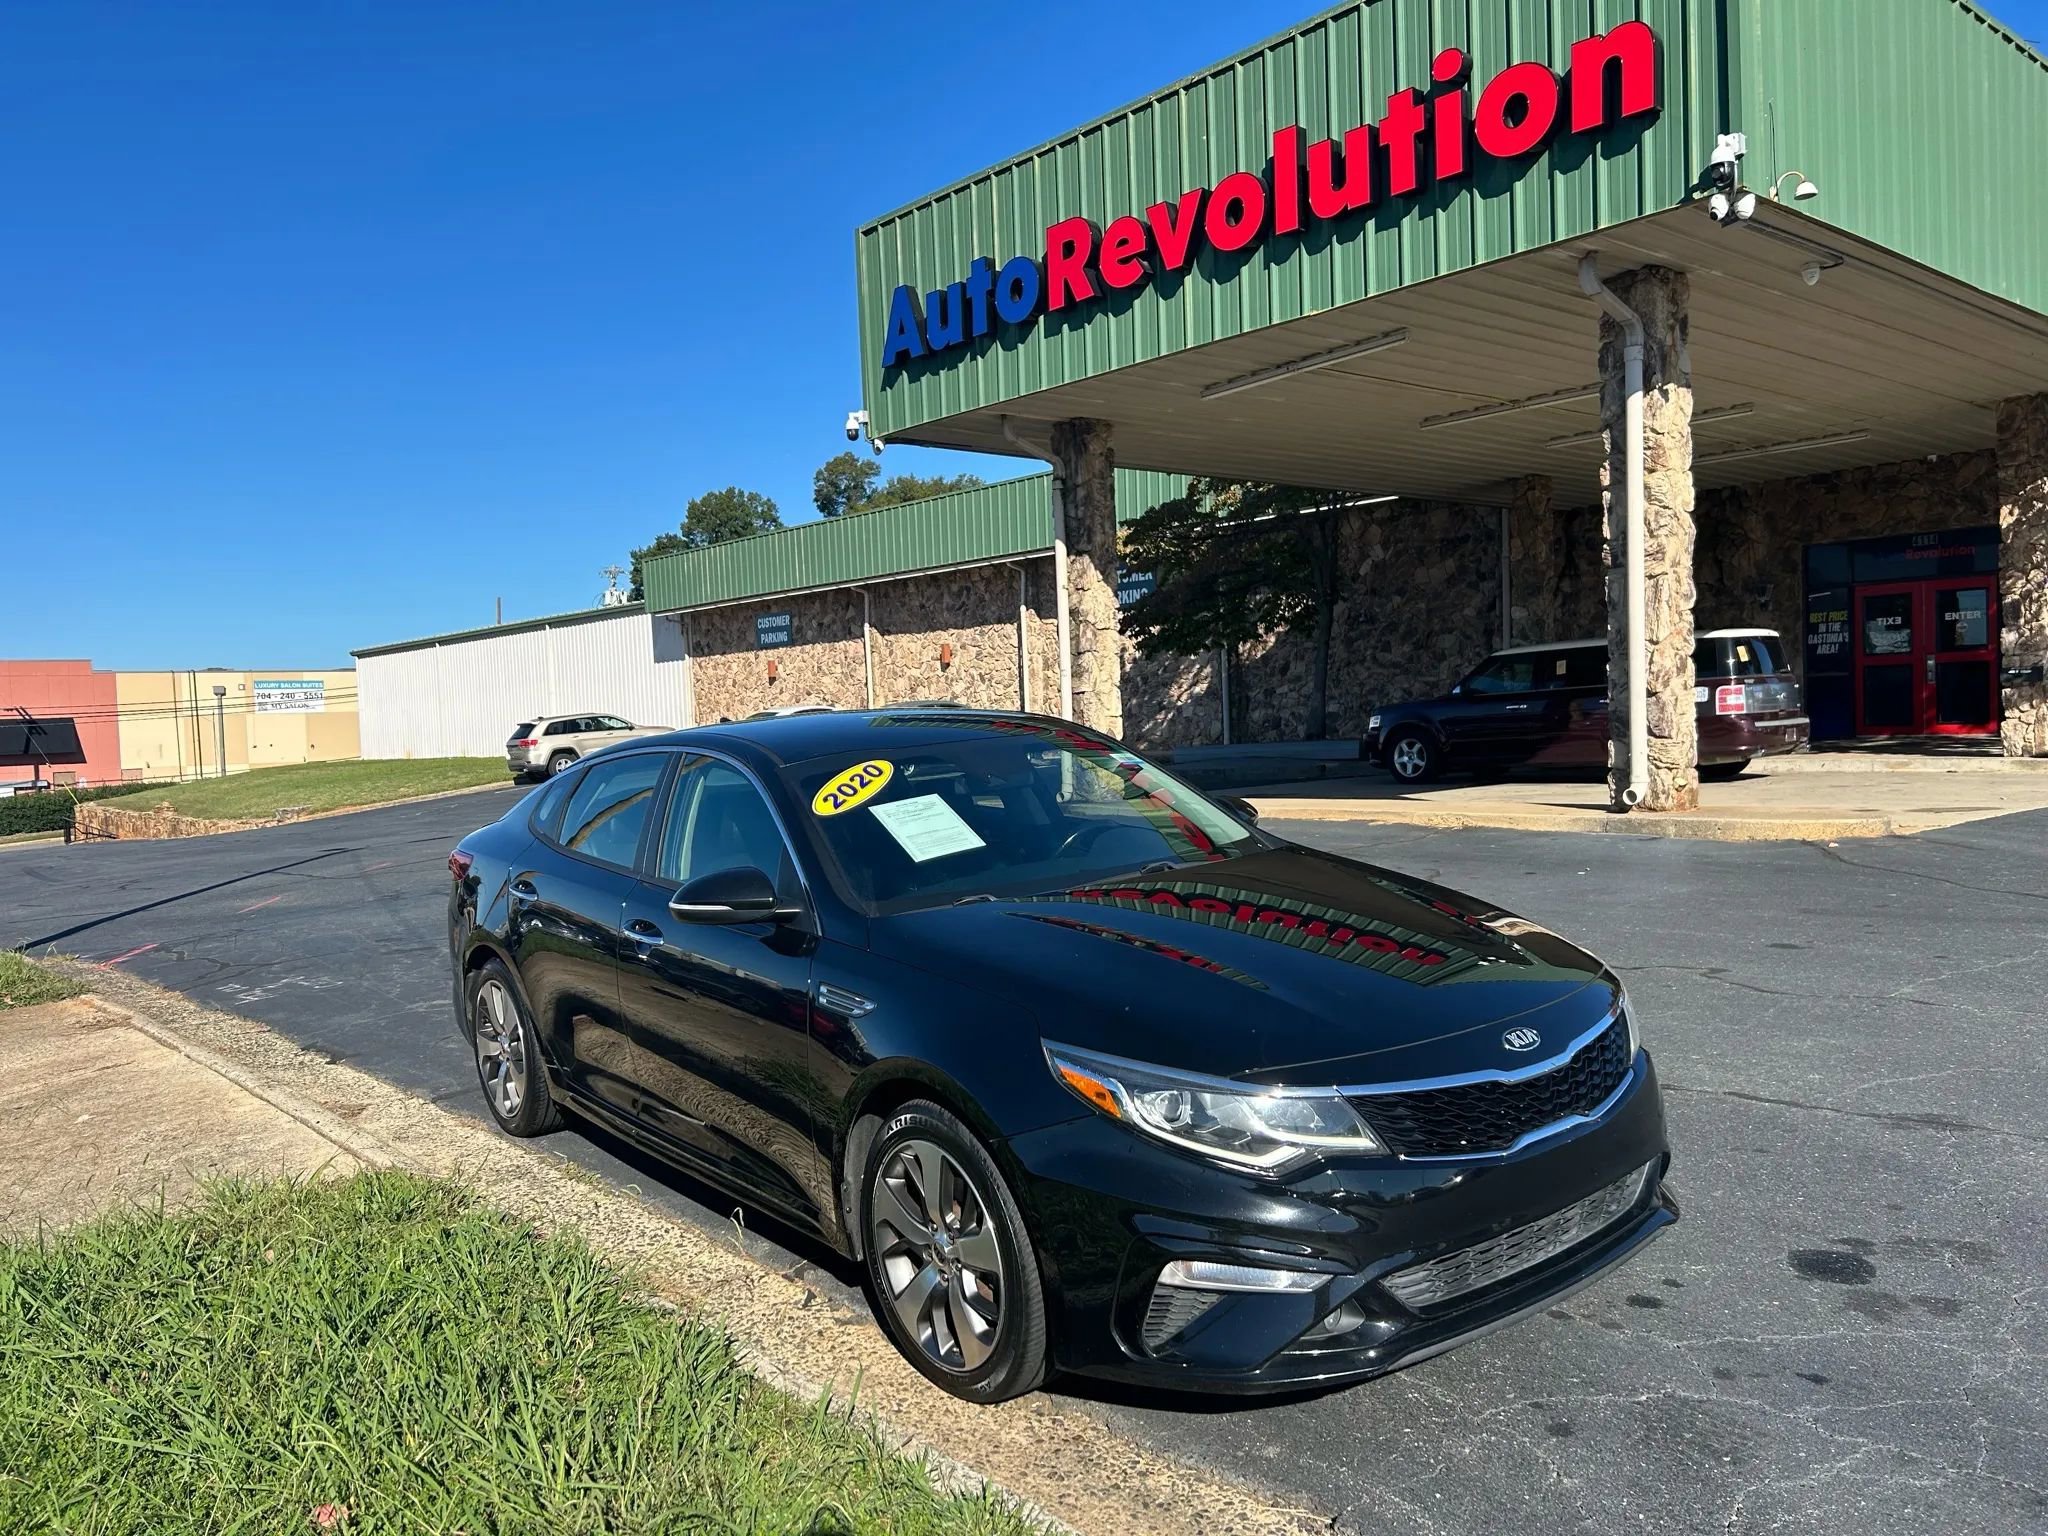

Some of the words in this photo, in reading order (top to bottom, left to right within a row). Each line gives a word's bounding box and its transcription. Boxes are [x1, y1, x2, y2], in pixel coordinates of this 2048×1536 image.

[757, 614, 790, 629] CUSTOMER
[1809, 611, 1828, 624] BEST
[1828, 610, 1849, 622] PRICE
[1944, 610, 1982, 621] ENTER
[1818, 622, 1827, 633] IN
[1827, 621, 1842, 632] THE
[760, 630, 788, 644] PARKING
[1816, 643, 1839, 655] AREA!
[256, 692, 271, 700] 704
[822, 763, 884, 810] 2020
[1505, 1028, 1539, 1048] KIA
